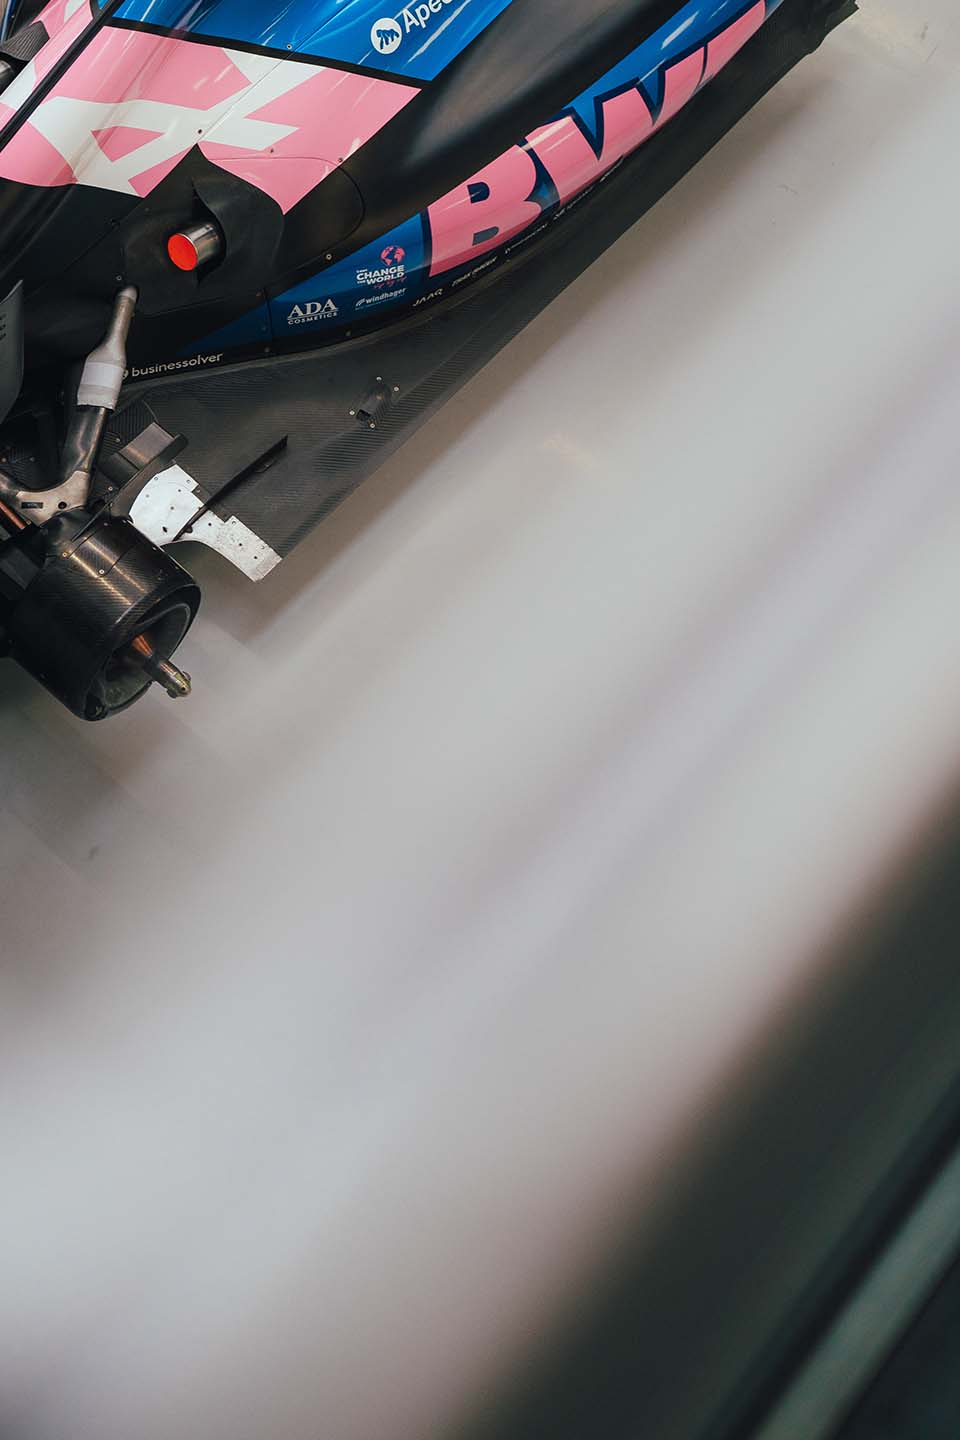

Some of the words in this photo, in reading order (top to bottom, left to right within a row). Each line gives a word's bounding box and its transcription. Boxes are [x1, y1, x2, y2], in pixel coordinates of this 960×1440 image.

[356, 265, 405, 282] CHANGE
[366, 271, 405, 286] WORLD
[288, 298, 338, 319] ADA
[288, 312, 338, 325] COSMETICS
[132, 353, 223, 378] businessolver
